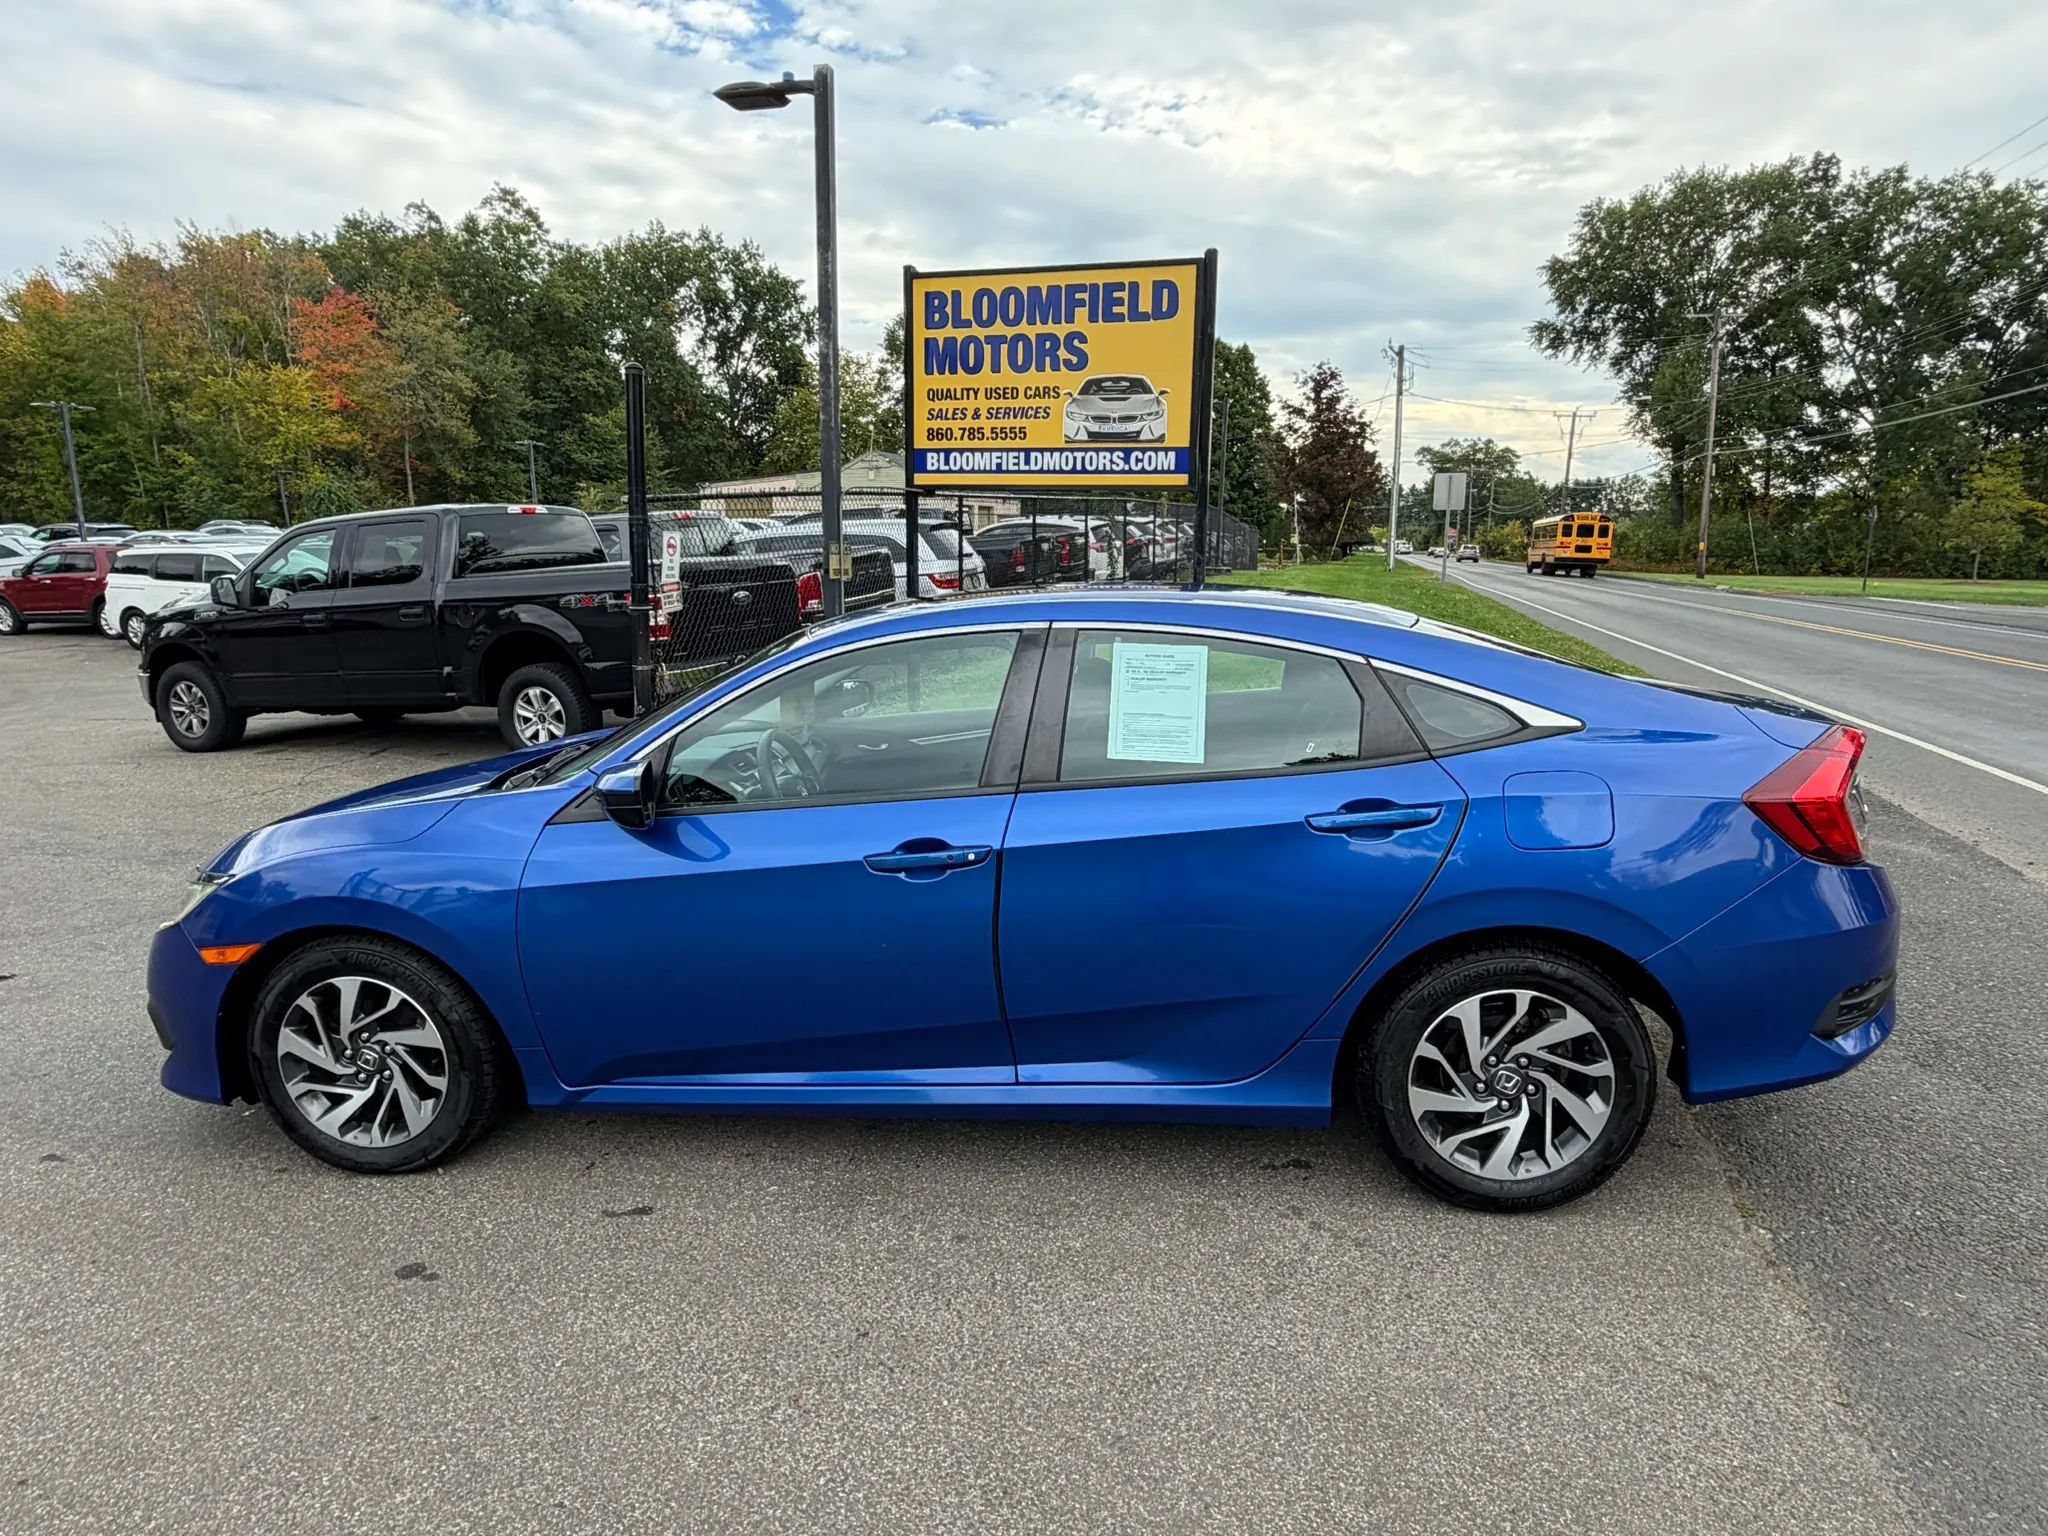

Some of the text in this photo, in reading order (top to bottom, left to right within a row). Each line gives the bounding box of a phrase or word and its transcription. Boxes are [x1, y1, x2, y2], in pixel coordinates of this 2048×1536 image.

[924, 279, 1180, 330] BLOOMFIELD
[923, 331, 1090, 376] MOTORS
[926, 385, 1061, 402] QUALITY USED CARS
[926, 406, 1052, 421] SALES & SERVICES
[926, 426, 1028, 442] 860.785.5555
[926, 451, 1176, 471] BLOOMFIELDMOTORS.COM
